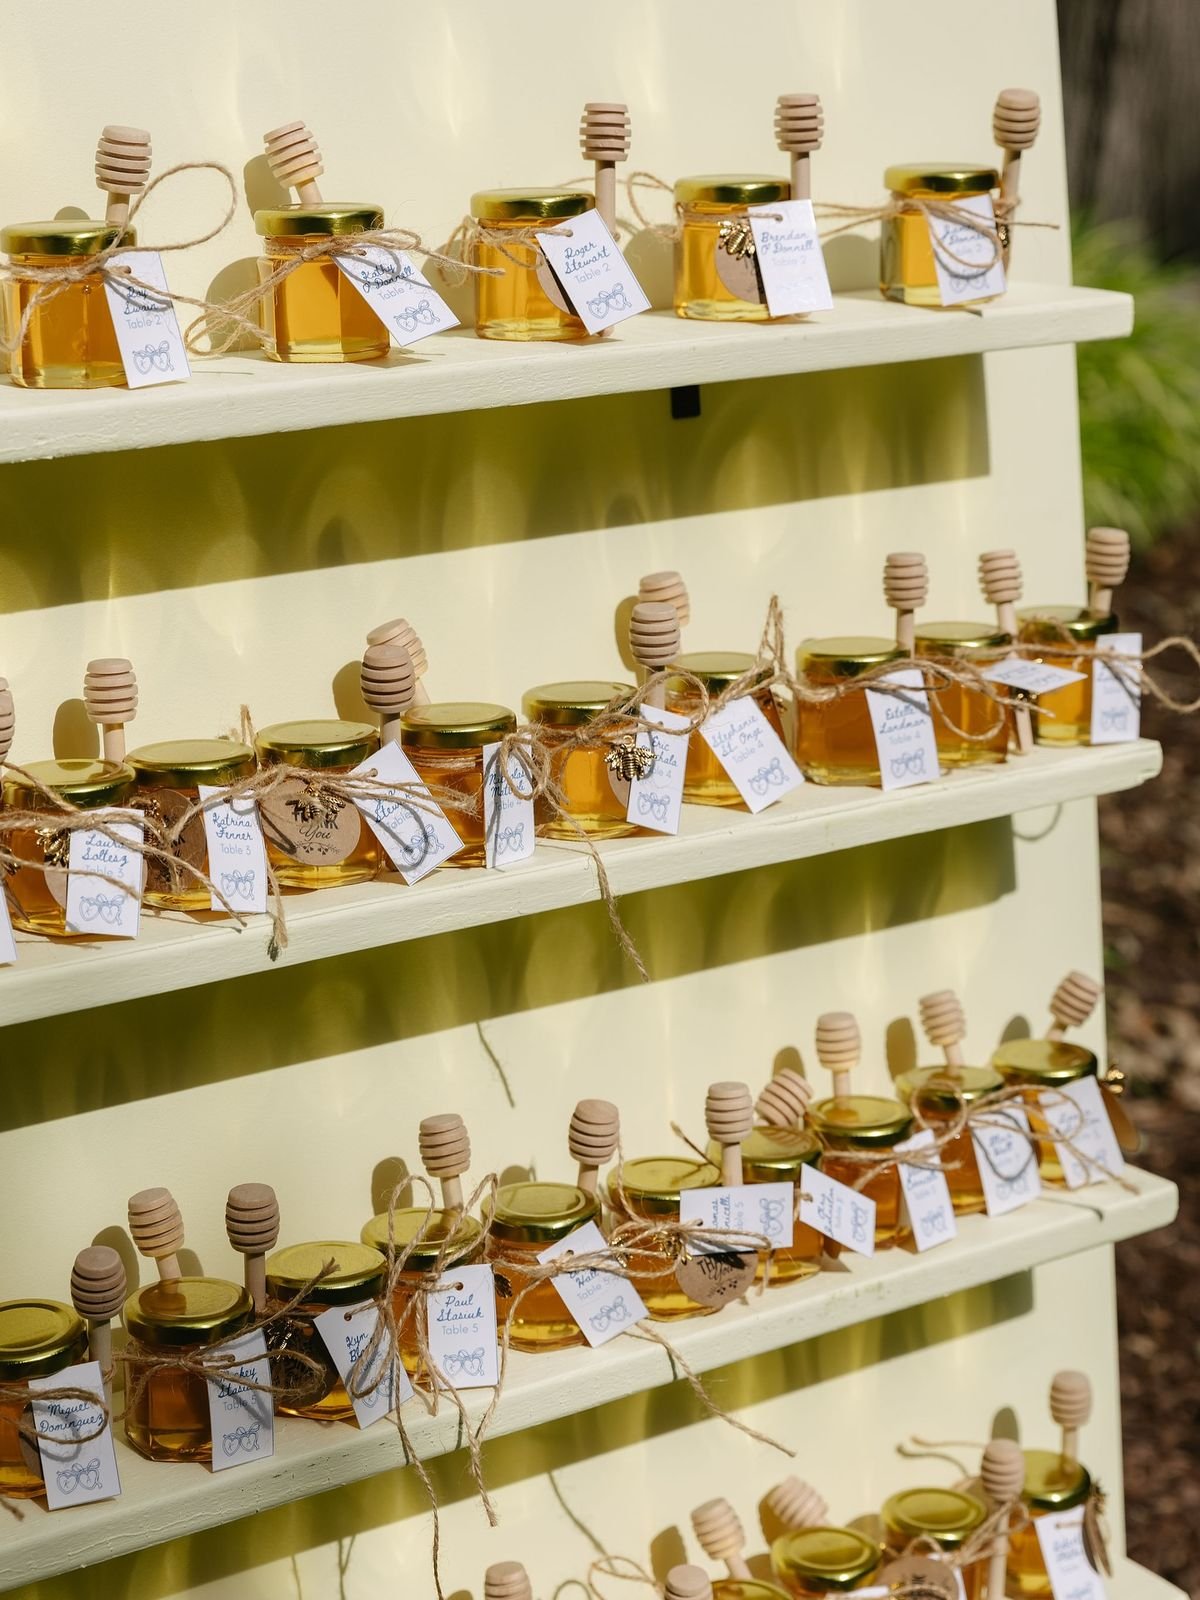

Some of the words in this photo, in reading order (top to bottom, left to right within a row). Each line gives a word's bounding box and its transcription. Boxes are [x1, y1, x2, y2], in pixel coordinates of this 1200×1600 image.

[761, 229, 809, 244] Brendan
[564, 242, 597, 259] Roger
[564, 246, 611, 275] Stewart
[361, 263, 396, 280] Kathy
[575, 268, 601, 284] Table
[602, 262, 612, 272] 2
[378, 284, 405, 300] Table
[408, 282, 415, 291] 2
[126, 317, 153, 330] Table
[155, 314, 162, 326] 2
[711, 715, 758, 749] Stephanie
[212, 812, 252, 828] Katrina
[216, 826, 253, 841] Fenner
[299, 824, 332, 842] You
[220, 843, 242, 855] Table
[246, 845, 252, 857] 3
[445, 1293, 474, 1307] Paul
[436, 1307, 485, 1322] Stasiuk
[442, 1324, 468, 1336] Table
[472, 1322, 479, 1333] 5
[345, 1332, 369, 1350] Kym
[47, 1402, 91, 1418] Miguel
[223, 1398, 248, 1412] Table
[251, 1394, 257, 1405] 5
[39, 1413, 105, 1433] Dominguez
